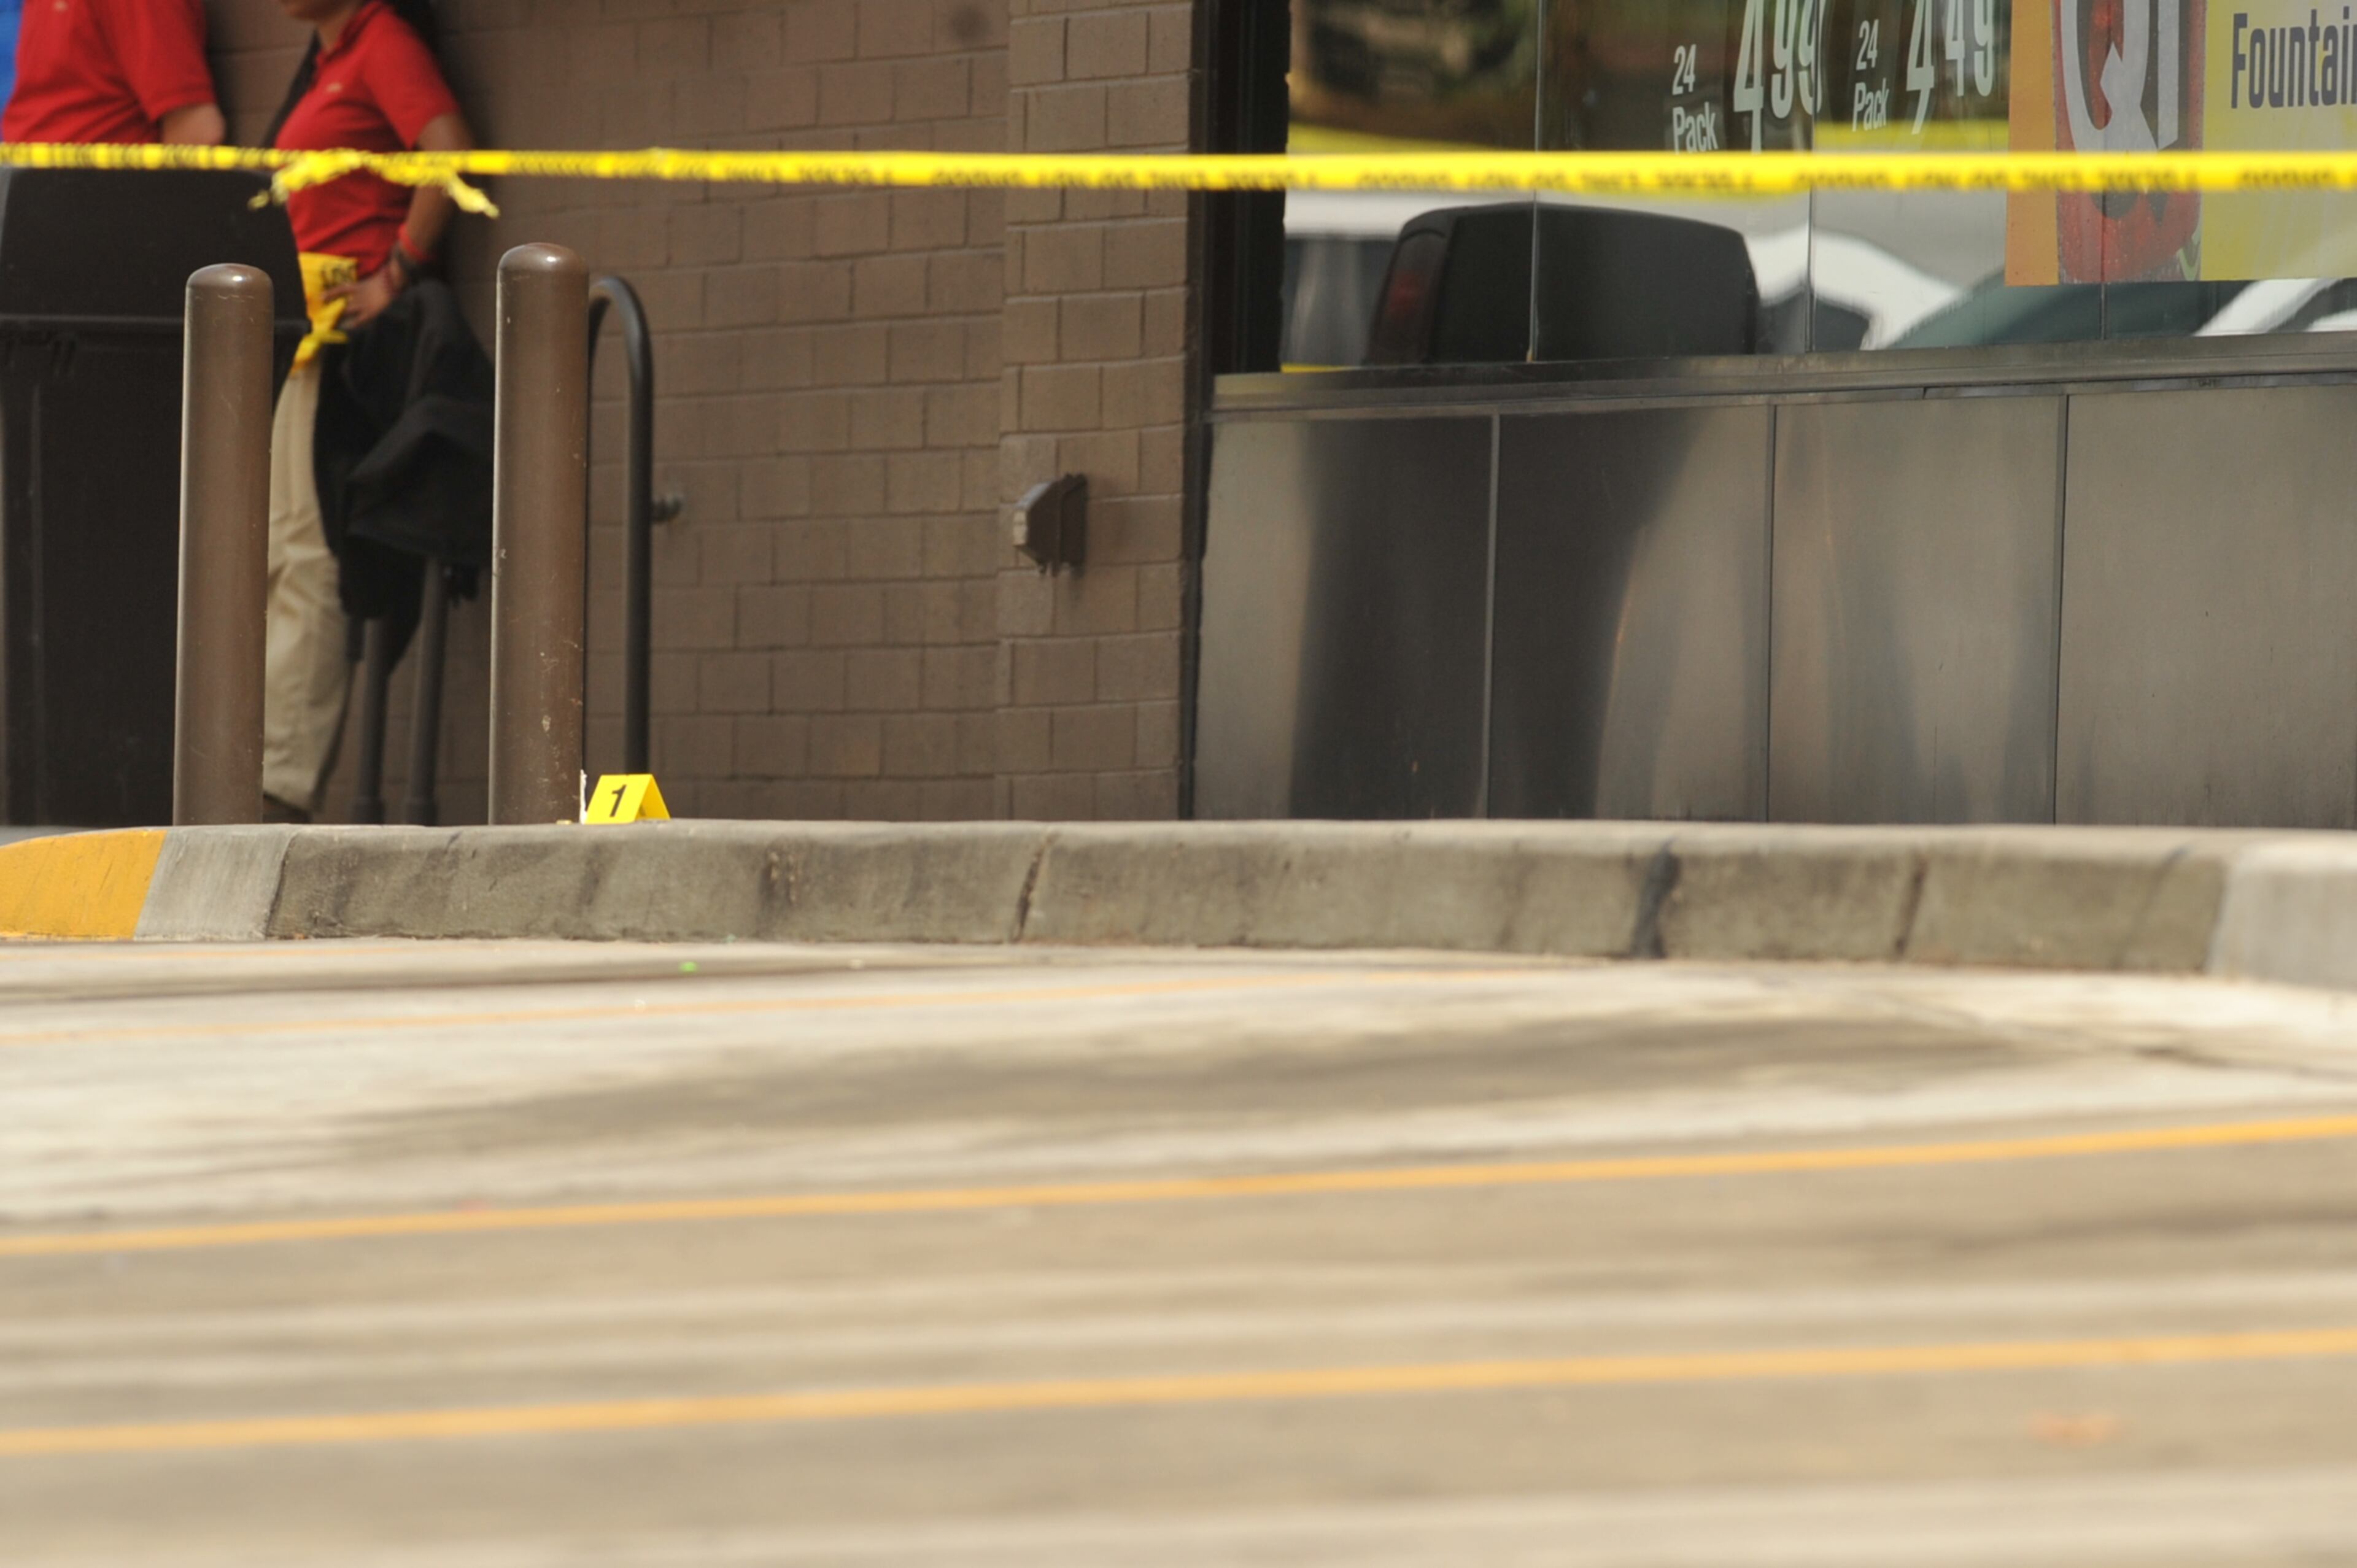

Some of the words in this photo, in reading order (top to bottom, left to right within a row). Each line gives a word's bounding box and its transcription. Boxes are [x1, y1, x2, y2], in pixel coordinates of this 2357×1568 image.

[1672, 44, 1697, 96] 24
[1856, 18, 1879, 71] 24
[1672, 101, 1719, 155] Pack
[1852, 77, 1890, 133] Pack
[609, 784, 627, 818] 1
